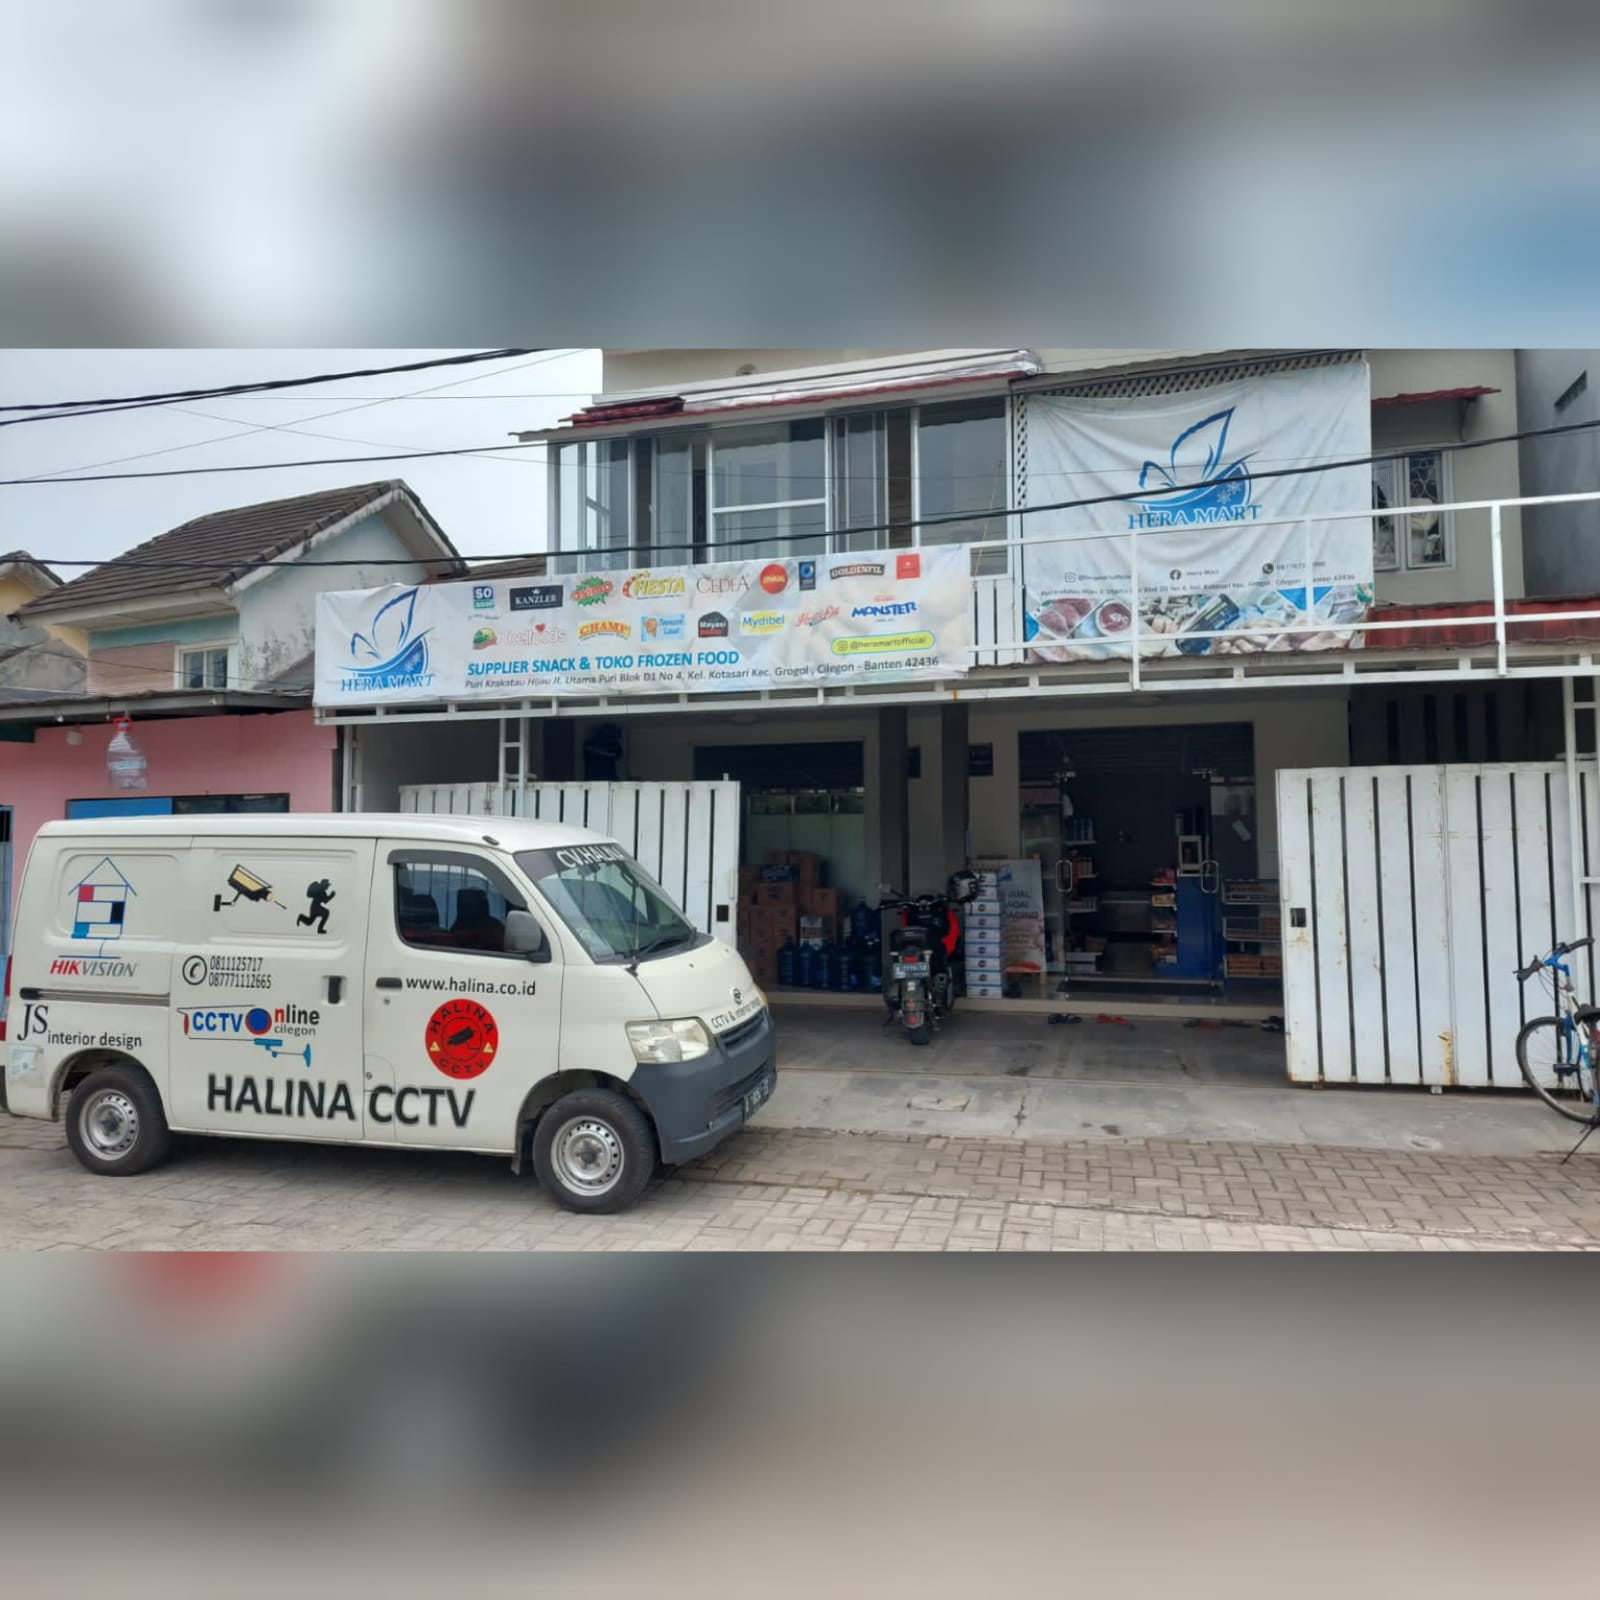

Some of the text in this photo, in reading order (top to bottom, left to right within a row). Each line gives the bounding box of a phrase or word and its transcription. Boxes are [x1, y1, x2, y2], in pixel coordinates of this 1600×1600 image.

[1128, 504, 1262, 530] HERA MART
[475, 588, 492, 600] SO
[632, 576, 686, 597] FIESTA
[514, 593, 557, 605] KANZLER
[851, 601, 917, 618] MONSTER
[579, 620, 630, 638] CHAMP
[743, 614, 786, 628] Mydibel
[465, 679, 483, 689] Puri
[485, 677, 525, 688] Krakatau
[565, 674, 596, 685] Utama
[599, 672, 617, 684] Puri
[619, 671, 641, 682] Blok
[659, 671, 673, 681] No
[709, 669, 749, 679] Kotasari
[775, 665, 808, 677] Grogol
[817, 663, 854, 675] Cilegon
[864, 659, 901, 671] Banten
[904, 656, 939, 667] 42436
[467, 650, 740, 676] SUPPLIER SNACK & TOKO FROZEN FOOD
[340, 673, 436, 692] HERA MART
[50, 960, 138, 977] HIKVISION
[210, 956, 263, 972] 0811125717
[208, 972, 272, 989] 087771112665
[406, 976, 536, 996] www.halina.co.id
[17, 1004, 142, 1049] JS interior design
[192, 1011, 243, 1032] CCTV
[430, 1002, 494, 1035] HALINA
[274, 1024, 316, 1037] cilegon
[207, 1073, 476, 1128] HALINA CCTV
